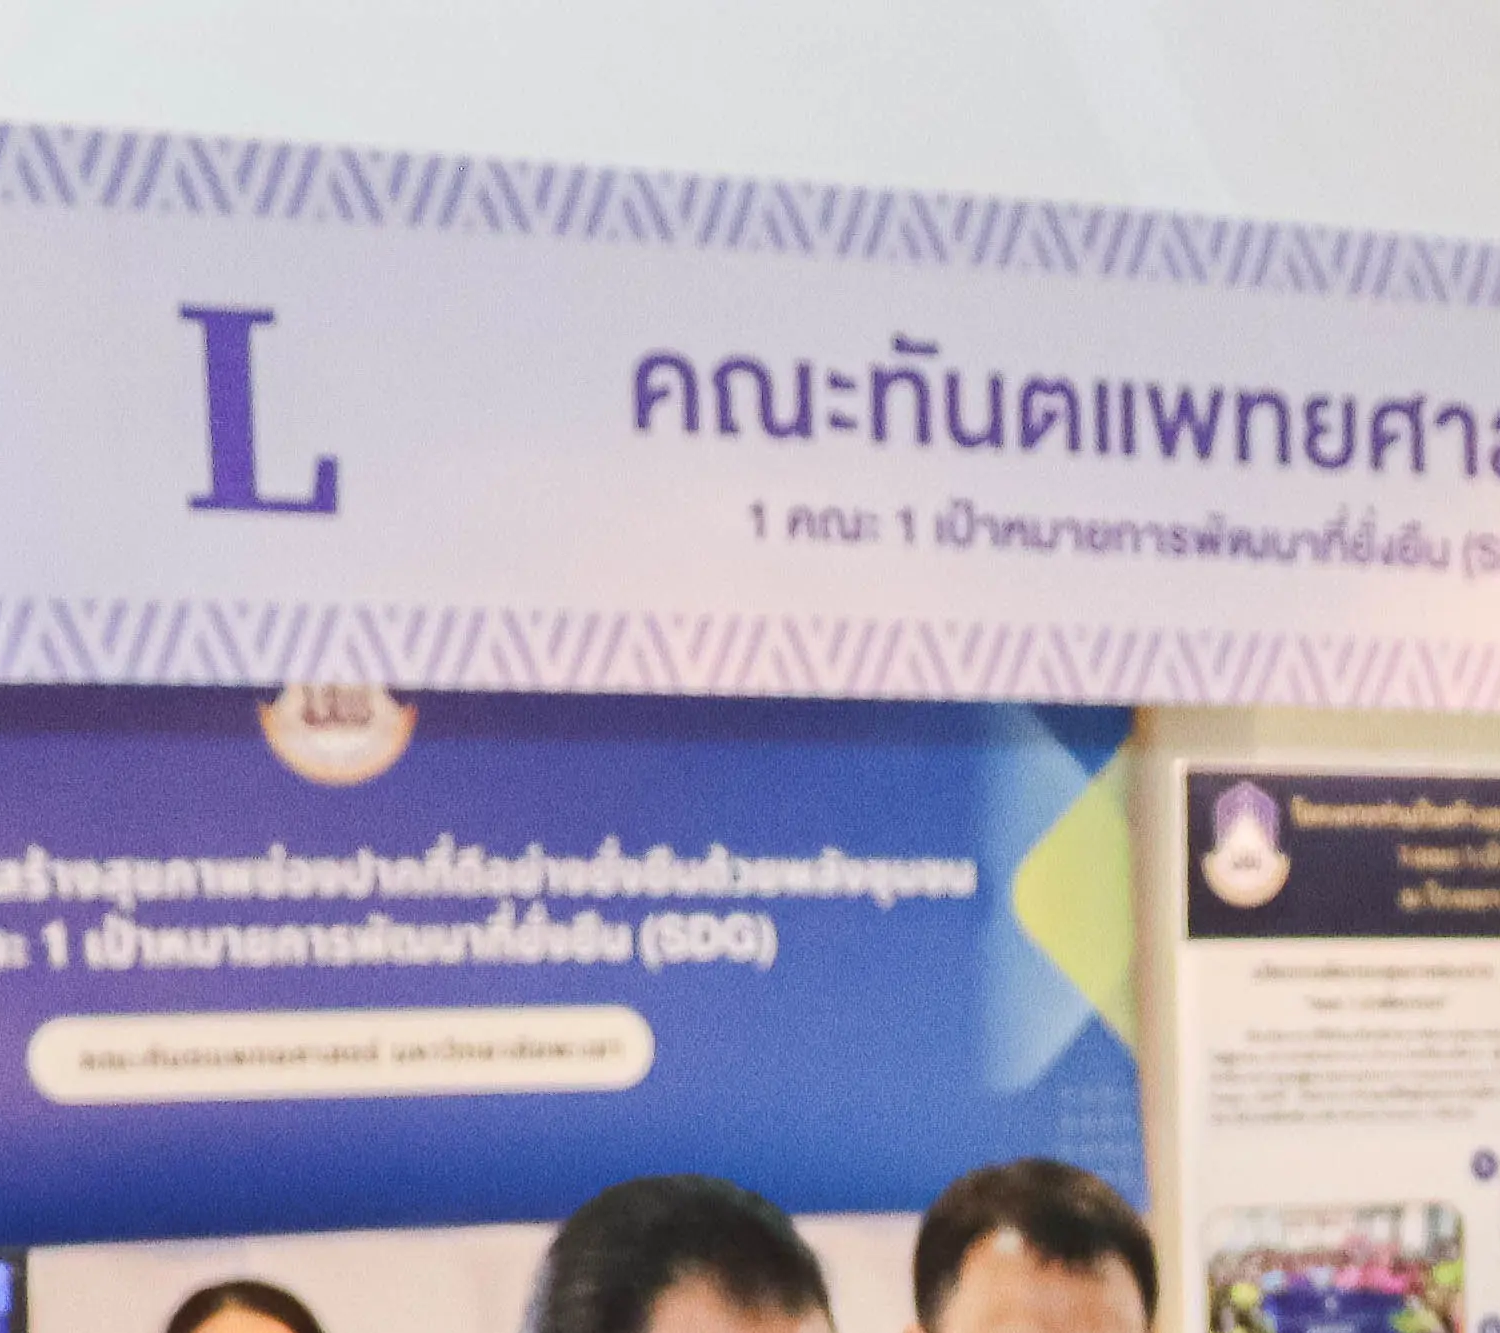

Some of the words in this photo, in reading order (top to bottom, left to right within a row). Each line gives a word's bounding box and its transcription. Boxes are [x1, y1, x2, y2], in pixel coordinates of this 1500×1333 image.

[178, 305, 340, 513] L
[749, 499, 767, 541] 1
[786, 503, 879, 543] คณะ
[898, 504, 915, 545] 1
[41, 917, 69, 971] 1
[636, 907, 779, 971] (SDG)
